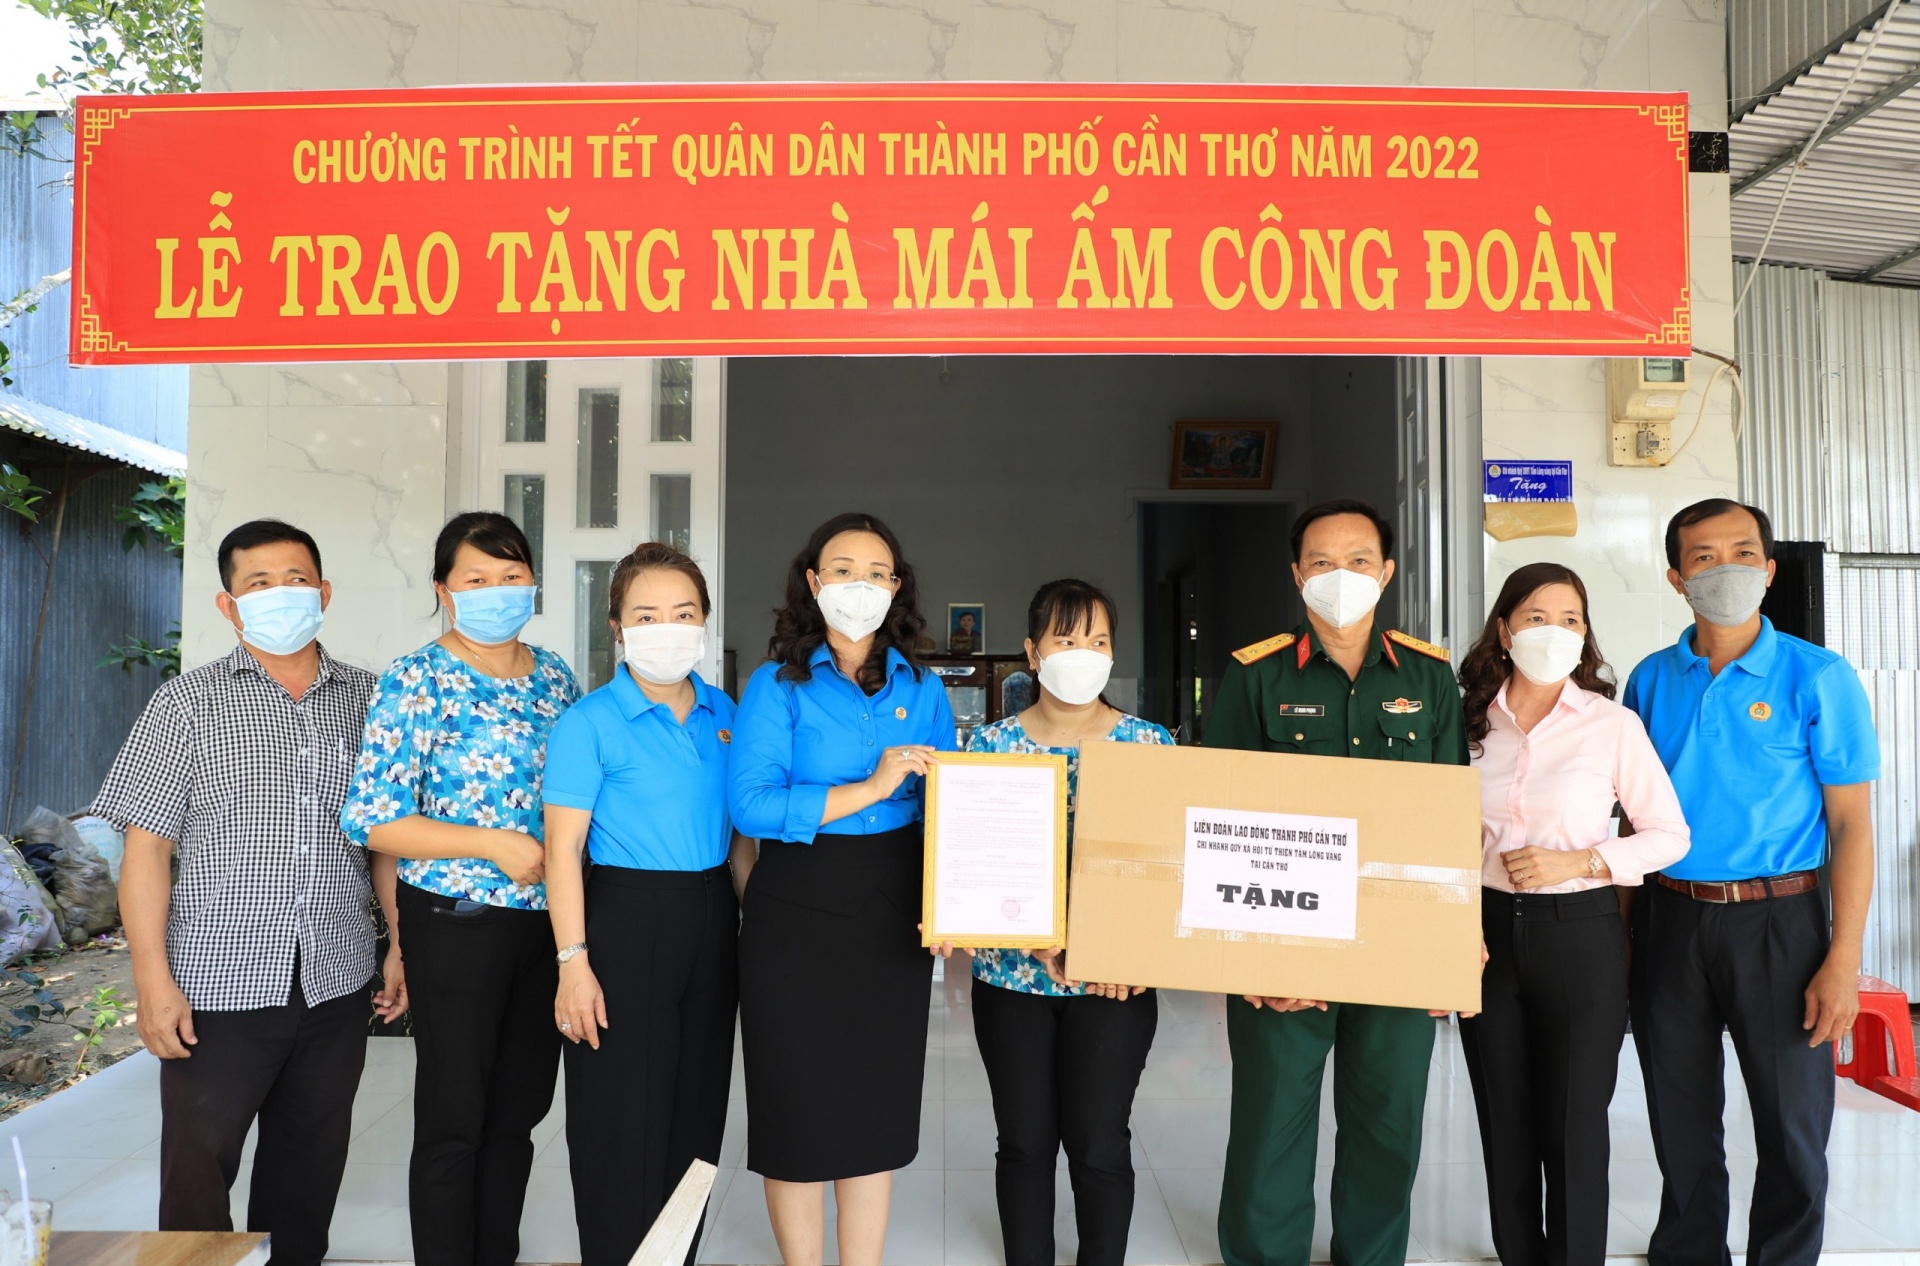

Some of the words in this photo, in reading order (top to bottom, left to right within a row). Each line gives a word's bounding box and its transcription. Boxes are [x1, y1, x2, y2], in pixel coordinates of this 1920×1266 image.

[294, 130, 445, 183] CHƯƠNG
[459, 125, 571, 179] TRÌNH
[587, 117, 657, 177] TẾT
[673, 121, 773, 185] QUÂN
[789, 121, 864, 175] DÂN
[880, 120, 1006, 175] THÀNH
[1024, 115, 1104, 176] PHỐ
[1113, 115, 1186, 176] CẦN
[1201, 127, 1279, 177] THƠ
[1292, 125, 1371, 177] NĂM
[1387, 135, 1479, 178] 2022
[155, 191, 242, 318] LỄ
[270, 231, 460, 316] TRAO
[487, 207, 685, 335] TẶNG
[712, 202, 868, 310] NHÀ
[893, 201, 1034, 309] MÁI
[1057, 185, 1173, 308] ẤM
[1201, 202, 1399, 311] CÔNG
[1424, 205, 1617, 311] ĐOÀN
[1509, 476, 1548, 494] Tặng
[1194, 819, 1211, 834] LIÊN
[1213, 820, 1233, 836] ĐOÀN
[1234, 825, 1248, 838] LAO
[1250, 823, 1270, 841] ĐỘNG
[1271, 826, 1296, 842] THÀNH
[1298, 827, 1313, 844] PHỐ
[1332, 833, 1348, 847] THƠ
[1197, 840, 1207, 849] CHI
[1216, 882, 1319, 911] TẶNG
